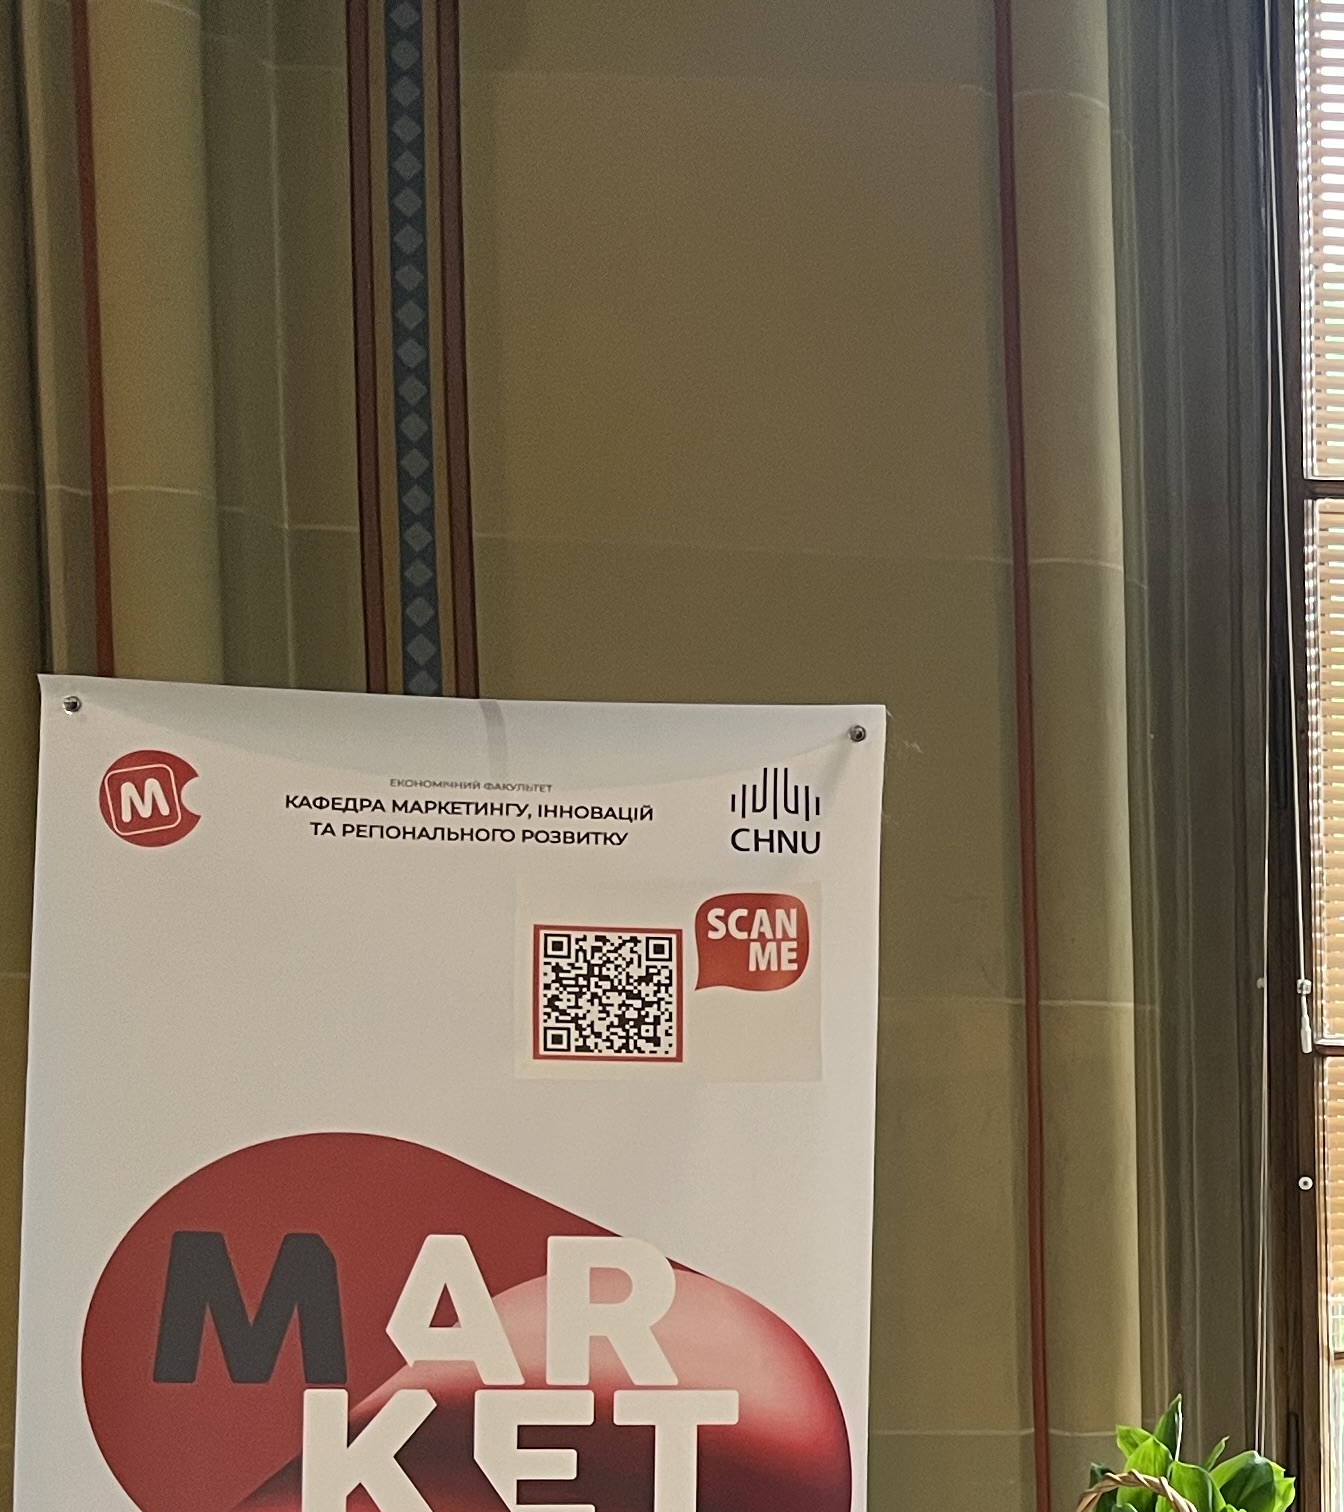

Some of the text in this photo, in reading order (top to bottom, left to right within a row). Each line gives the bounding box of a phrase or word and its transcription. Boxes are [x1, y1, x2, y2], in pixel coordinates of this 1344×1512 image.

[121, 777, 170, 823] M
[389, 778, 553, 793] ЕКОНОМІЧНИЙ ФАКУЛЬТЕТ
[285, 794, 654, 822] КАФЕДРА МАРКЕТИНГУ, ІННОВАЦІЙ
[310, 821, 629, 846] ТА РЕГІОНАЛЬНОГО РОЗВИТКУ
[730, 827, 821, 854] CHNU
[707, 907, 798, 940] SCAN
[748, 941, 798, 971] ME
[152, 1230, 678, 1386] MAR
